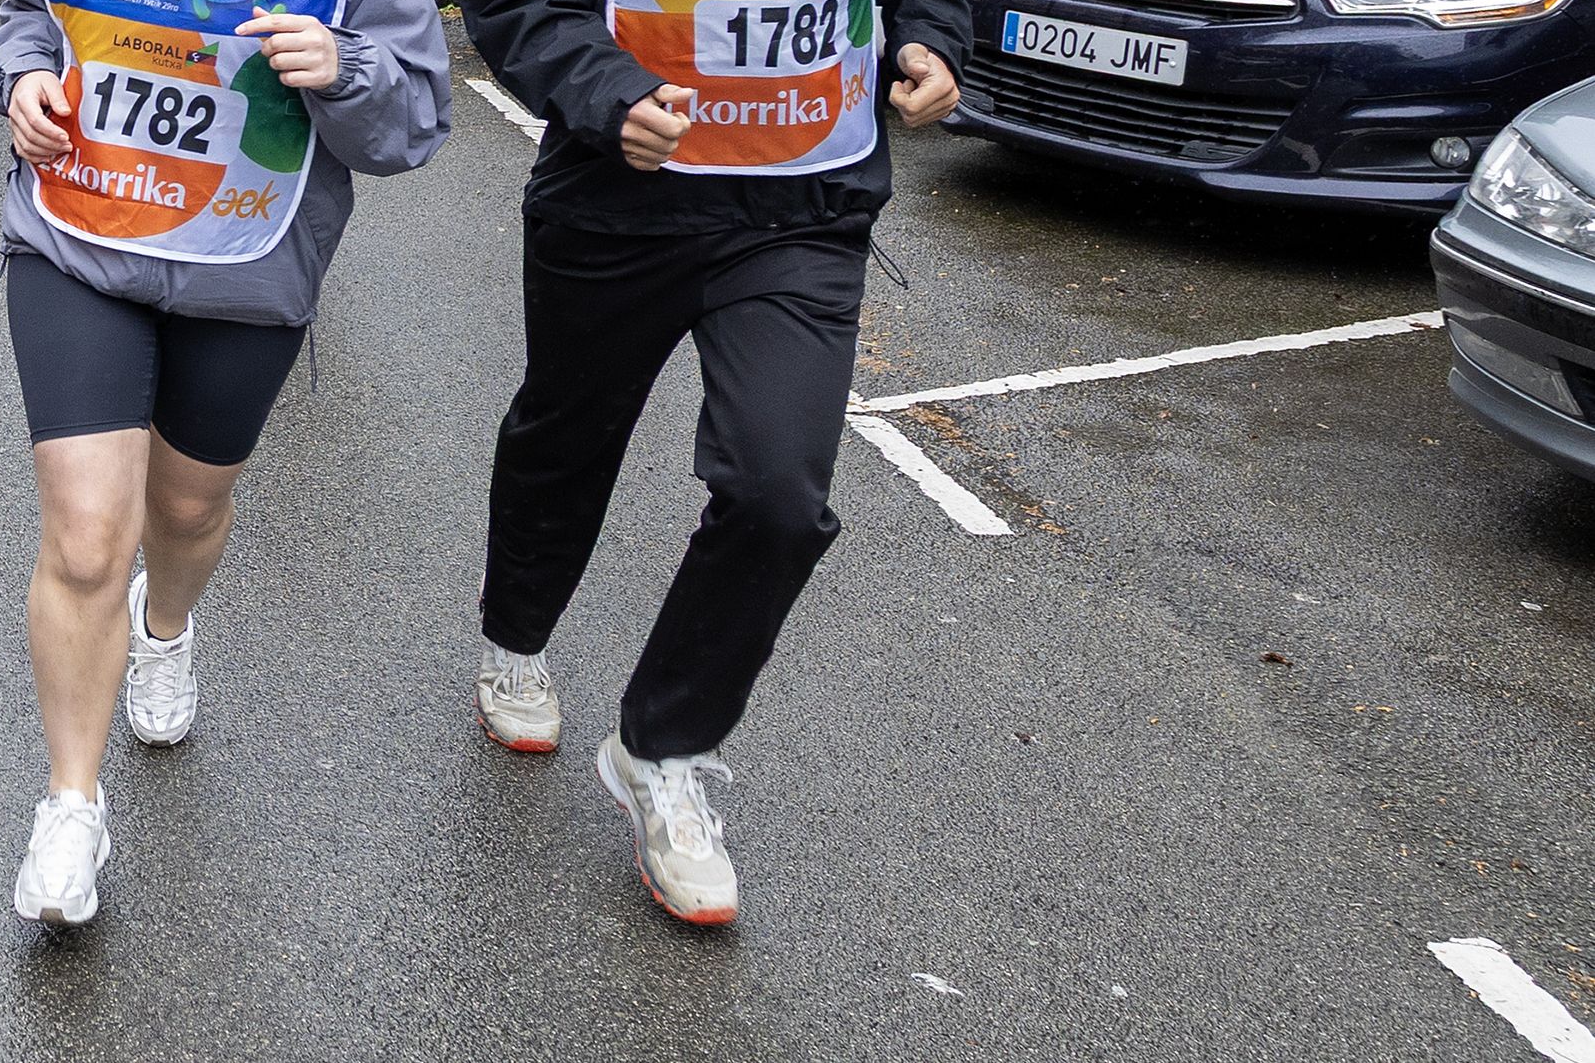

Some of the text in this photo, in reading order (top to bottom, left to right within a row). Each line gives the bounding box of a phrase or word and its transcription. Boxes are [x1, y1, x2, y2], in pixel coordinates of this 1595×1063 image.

[113, 34, 183, 60] LABORAL
[152, 56, 183, 70] kutxa
[1006, 20, 1177, 75] E 0204 JMF
[94, 72, 217, 155] 1782
[212, 180, 280, 221] aek
